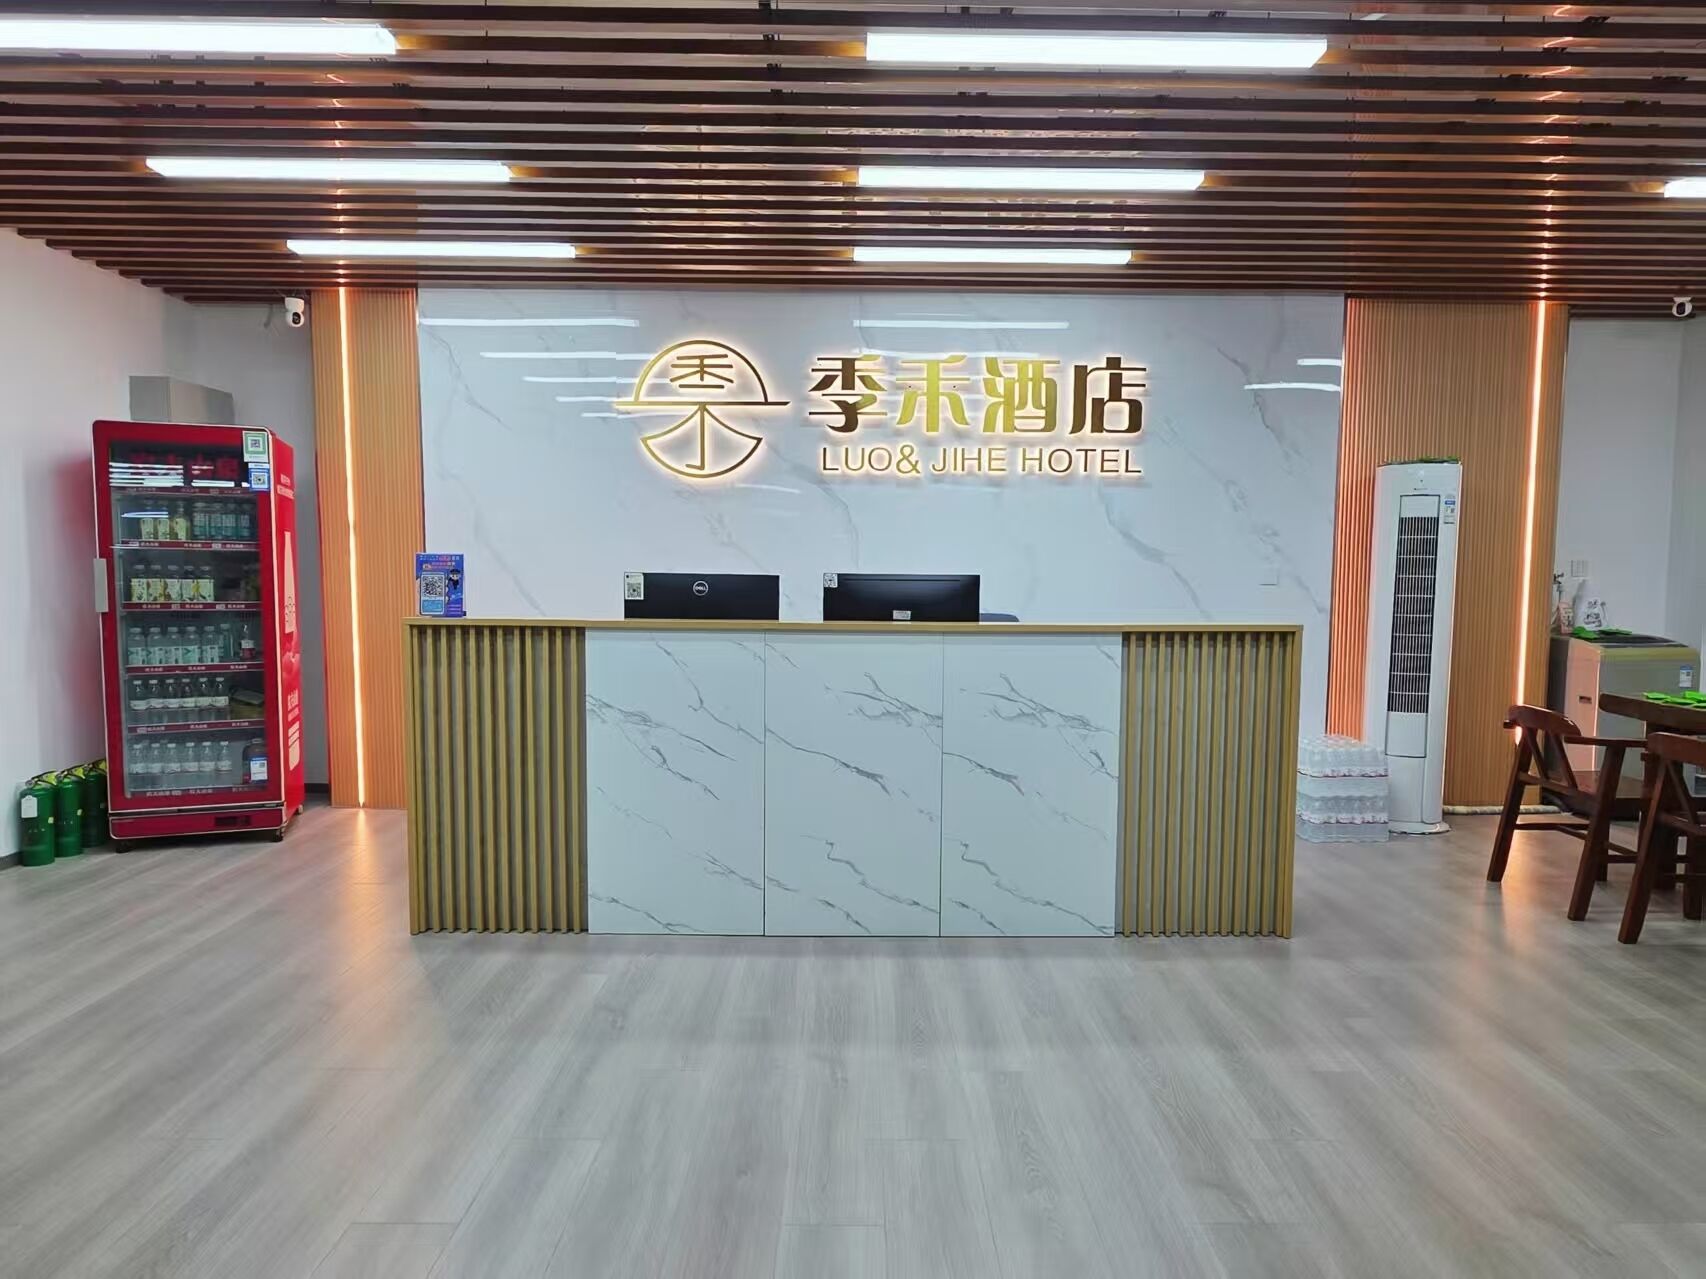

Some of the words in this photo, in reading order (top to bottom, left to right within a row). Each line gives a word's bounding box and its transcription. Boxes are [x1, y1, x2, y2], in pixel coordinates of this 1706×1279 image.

[808, 354, 1147, 435] 季禾酒店
[822, 444, 921, 474] LUO&
[931, 447, 1007, 473] JIHE
[1021, 448, 1143, 474] HOTEL
